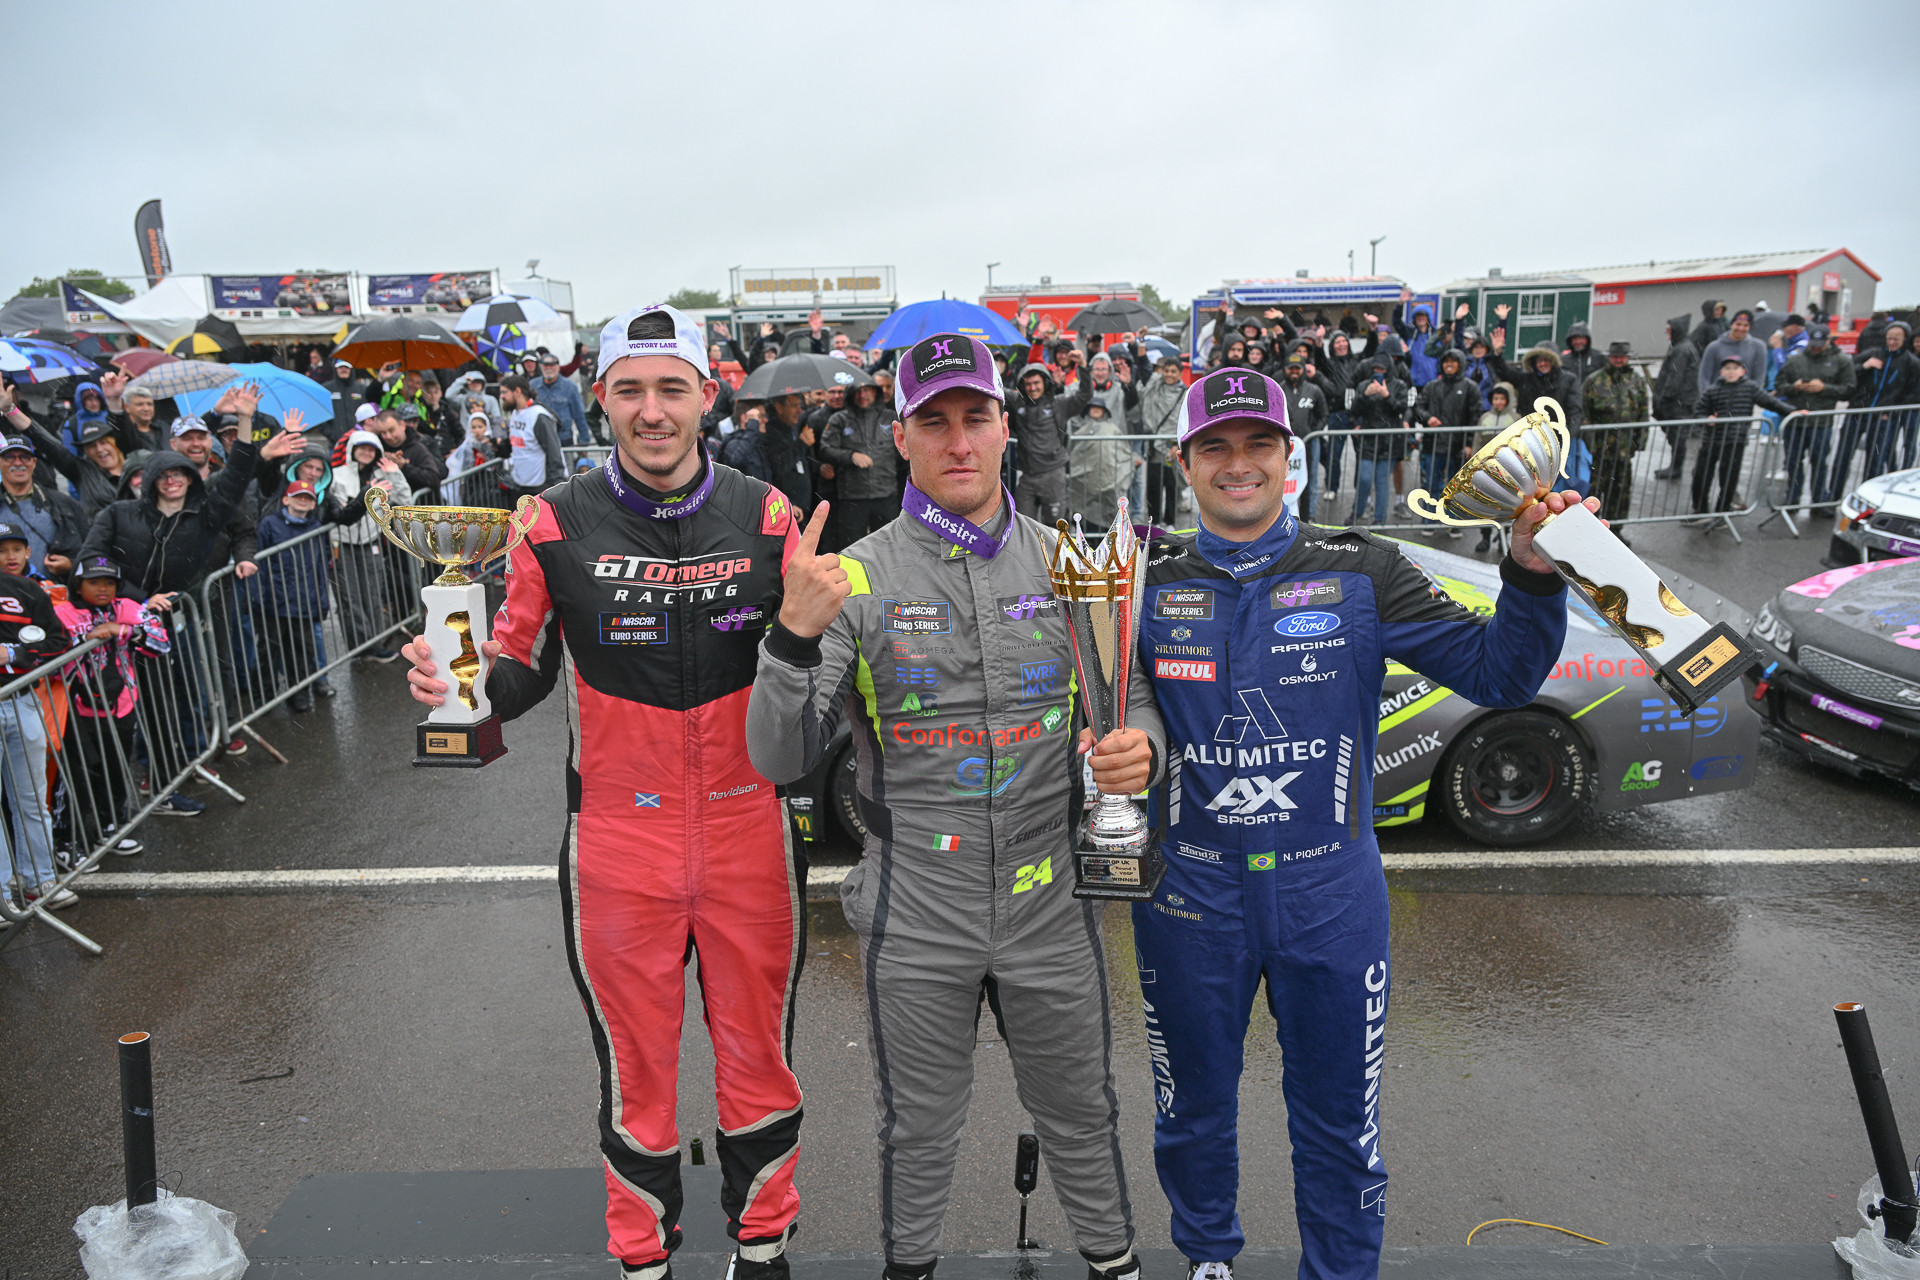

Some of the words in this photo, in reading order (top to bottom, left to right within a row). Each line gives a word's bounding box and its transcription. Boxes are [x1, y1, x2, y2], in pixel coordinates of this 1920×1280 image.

[744, 278, 819, 293] BURGERS
[823, 279, 834, 291] &
[837, 276, 881, 291] FRIES
[628, 342, 658, 350] VICTORY
[919, 358, 972, 377] HOOSIER
[1210, 396, 1264, 410] HOOSIER
[650, 489, 706, 519] Hoosier
[919, 503, 978, 545] Hoosier
[613, 584, 738, 605] RACING
[1175, 593, 1205, 602] NASCAR
[1276, 586, 1336, 599] HOOSIER
[903, 606, 938, 616] NASCAR
[1003, 600, 1057, 613] HOOSIER
[1162, 606, 1180, 615] EURO
[1181, 607, 1204, 616] SERIES
[621, 616, 657, 626] NASCAR
[710, 610, 763, 625] HOOSIER
[893, 619, 913, 631] EURO
[914, 620, 940, 631] SERIES
[1287, 615, 1328, 634] Ford
[610, 632, 631, 641] EURO
[632, 631, 658, 640] SERIES
[1154, 644, 1213, 657] STRATHMORE
[1271, 638, 1346, 654] RACING
[1023, 663, 1059, 681] WRK
[1156, 661, 1213, 679] MOTUL
[1279, 670, 1338, 685] OSMOLYT
[1026, 679, 1056, 697] MKT
[900, 692, 938, 711] AG
[1379, 680, 1432, 719] RVICE
[892, 721, 1042, 749] Conforama
[1183, 738, 1327, 768] ALUMITEC
[1374, 730, 1443, 777] llumix
[1622, 760, 1663, 783] AG
[708, 783, 758, 801] Davidson
[1620, 780, 1660, 791] GROUP
[1217, 811, 1290, 826] SPORTS
[1179, 845, 1220, 861] stand21
[1283, 853, 1294, 862] N.
[1295, 845, 1329, 860] PIQUET
[1329, 842, 1342, 852] JR.
[1012, 855, 1053, 895] 24
[1153, 902, 1203, 922] STRATHMORE
